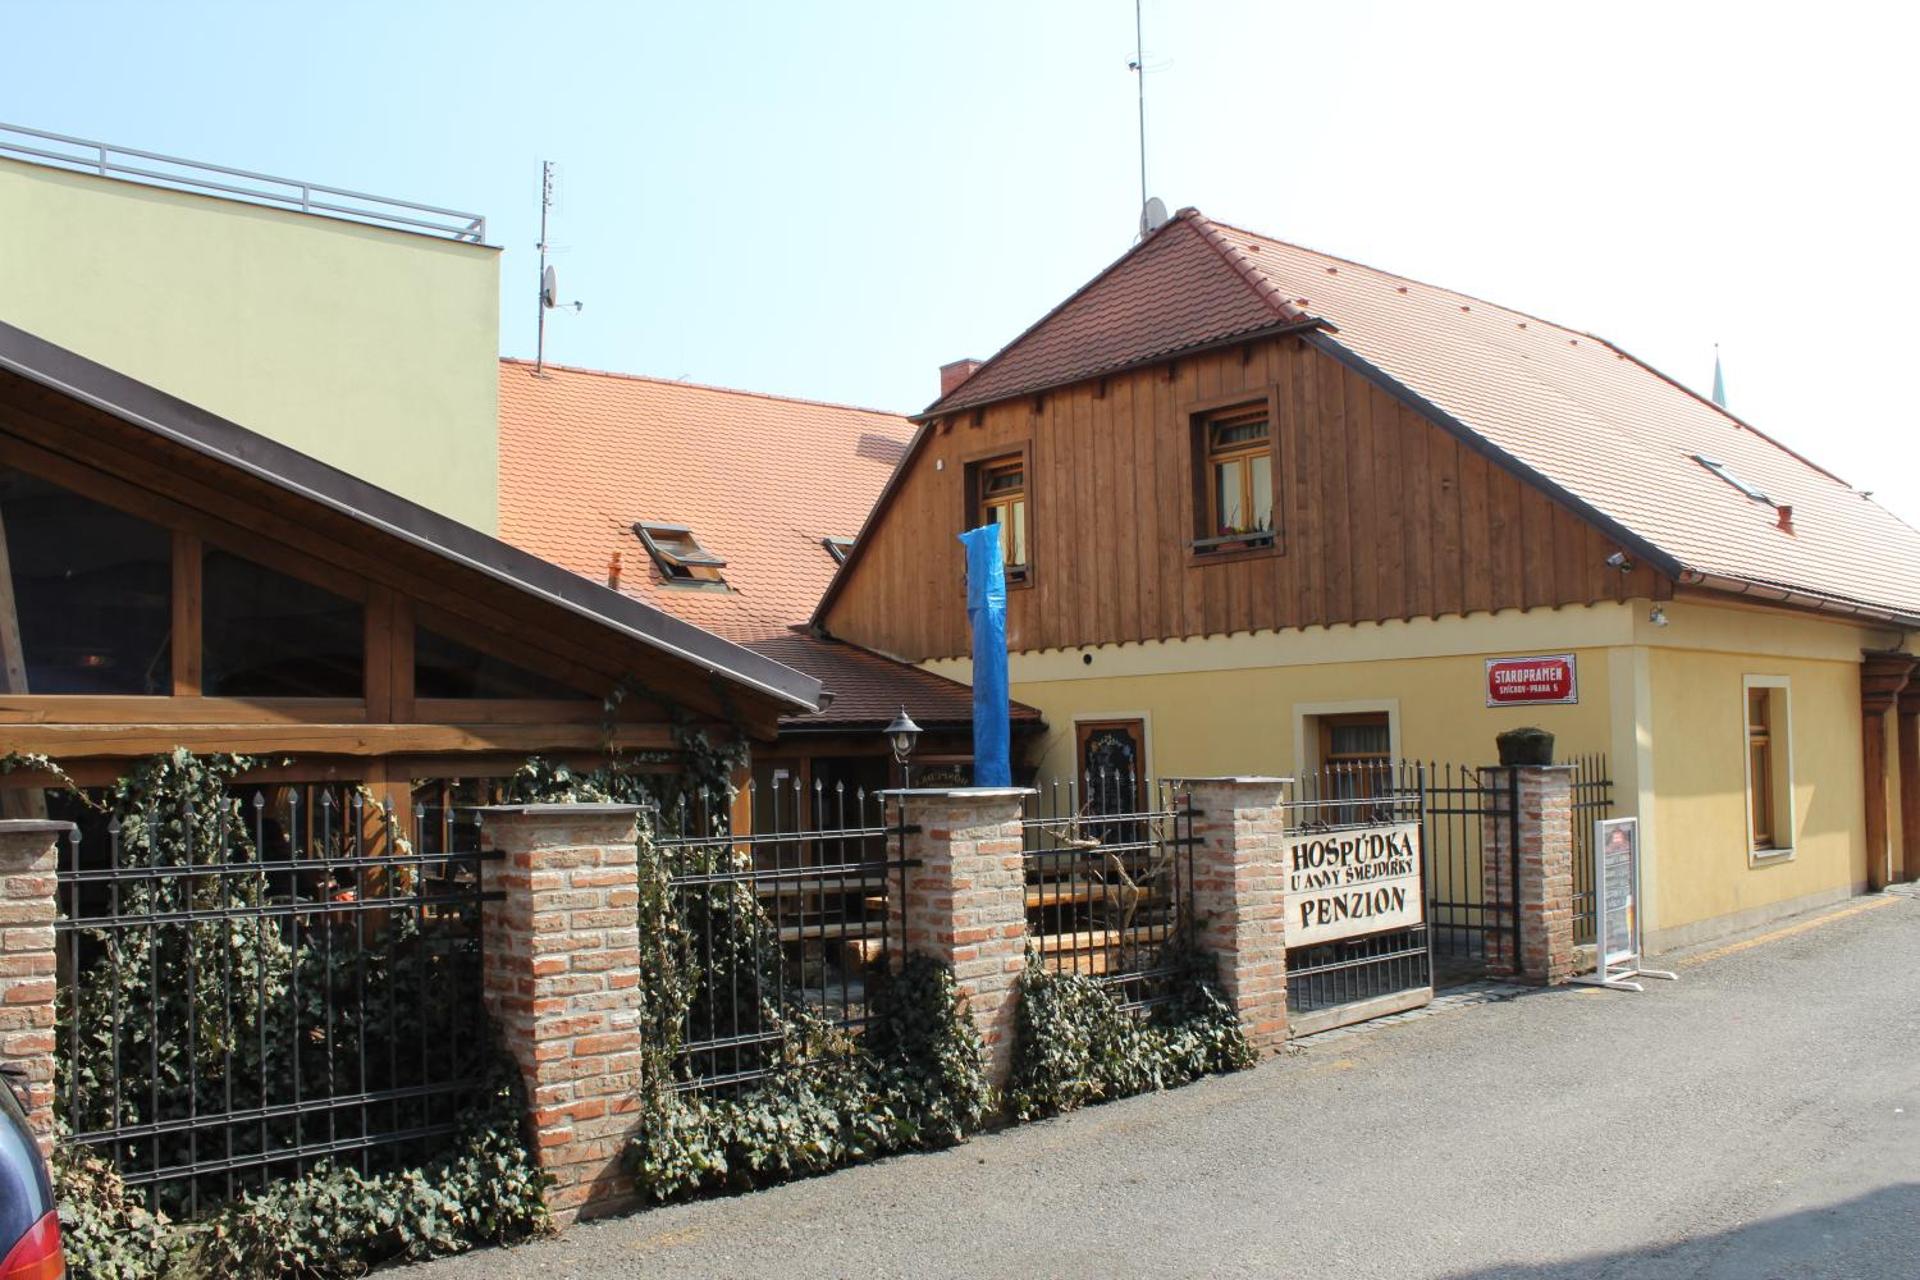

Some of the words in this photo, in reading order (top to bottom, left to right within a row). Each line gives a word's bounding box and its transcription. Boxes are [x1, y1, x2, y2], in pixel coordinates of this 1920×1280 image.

[1495, 667, 1563, 684] STAROPRAMEN
[1291, 875, 1300, 891] U
[1304, 869, 1340, 889] ANNY
[1300, 886, 1406, 929] PENZION
